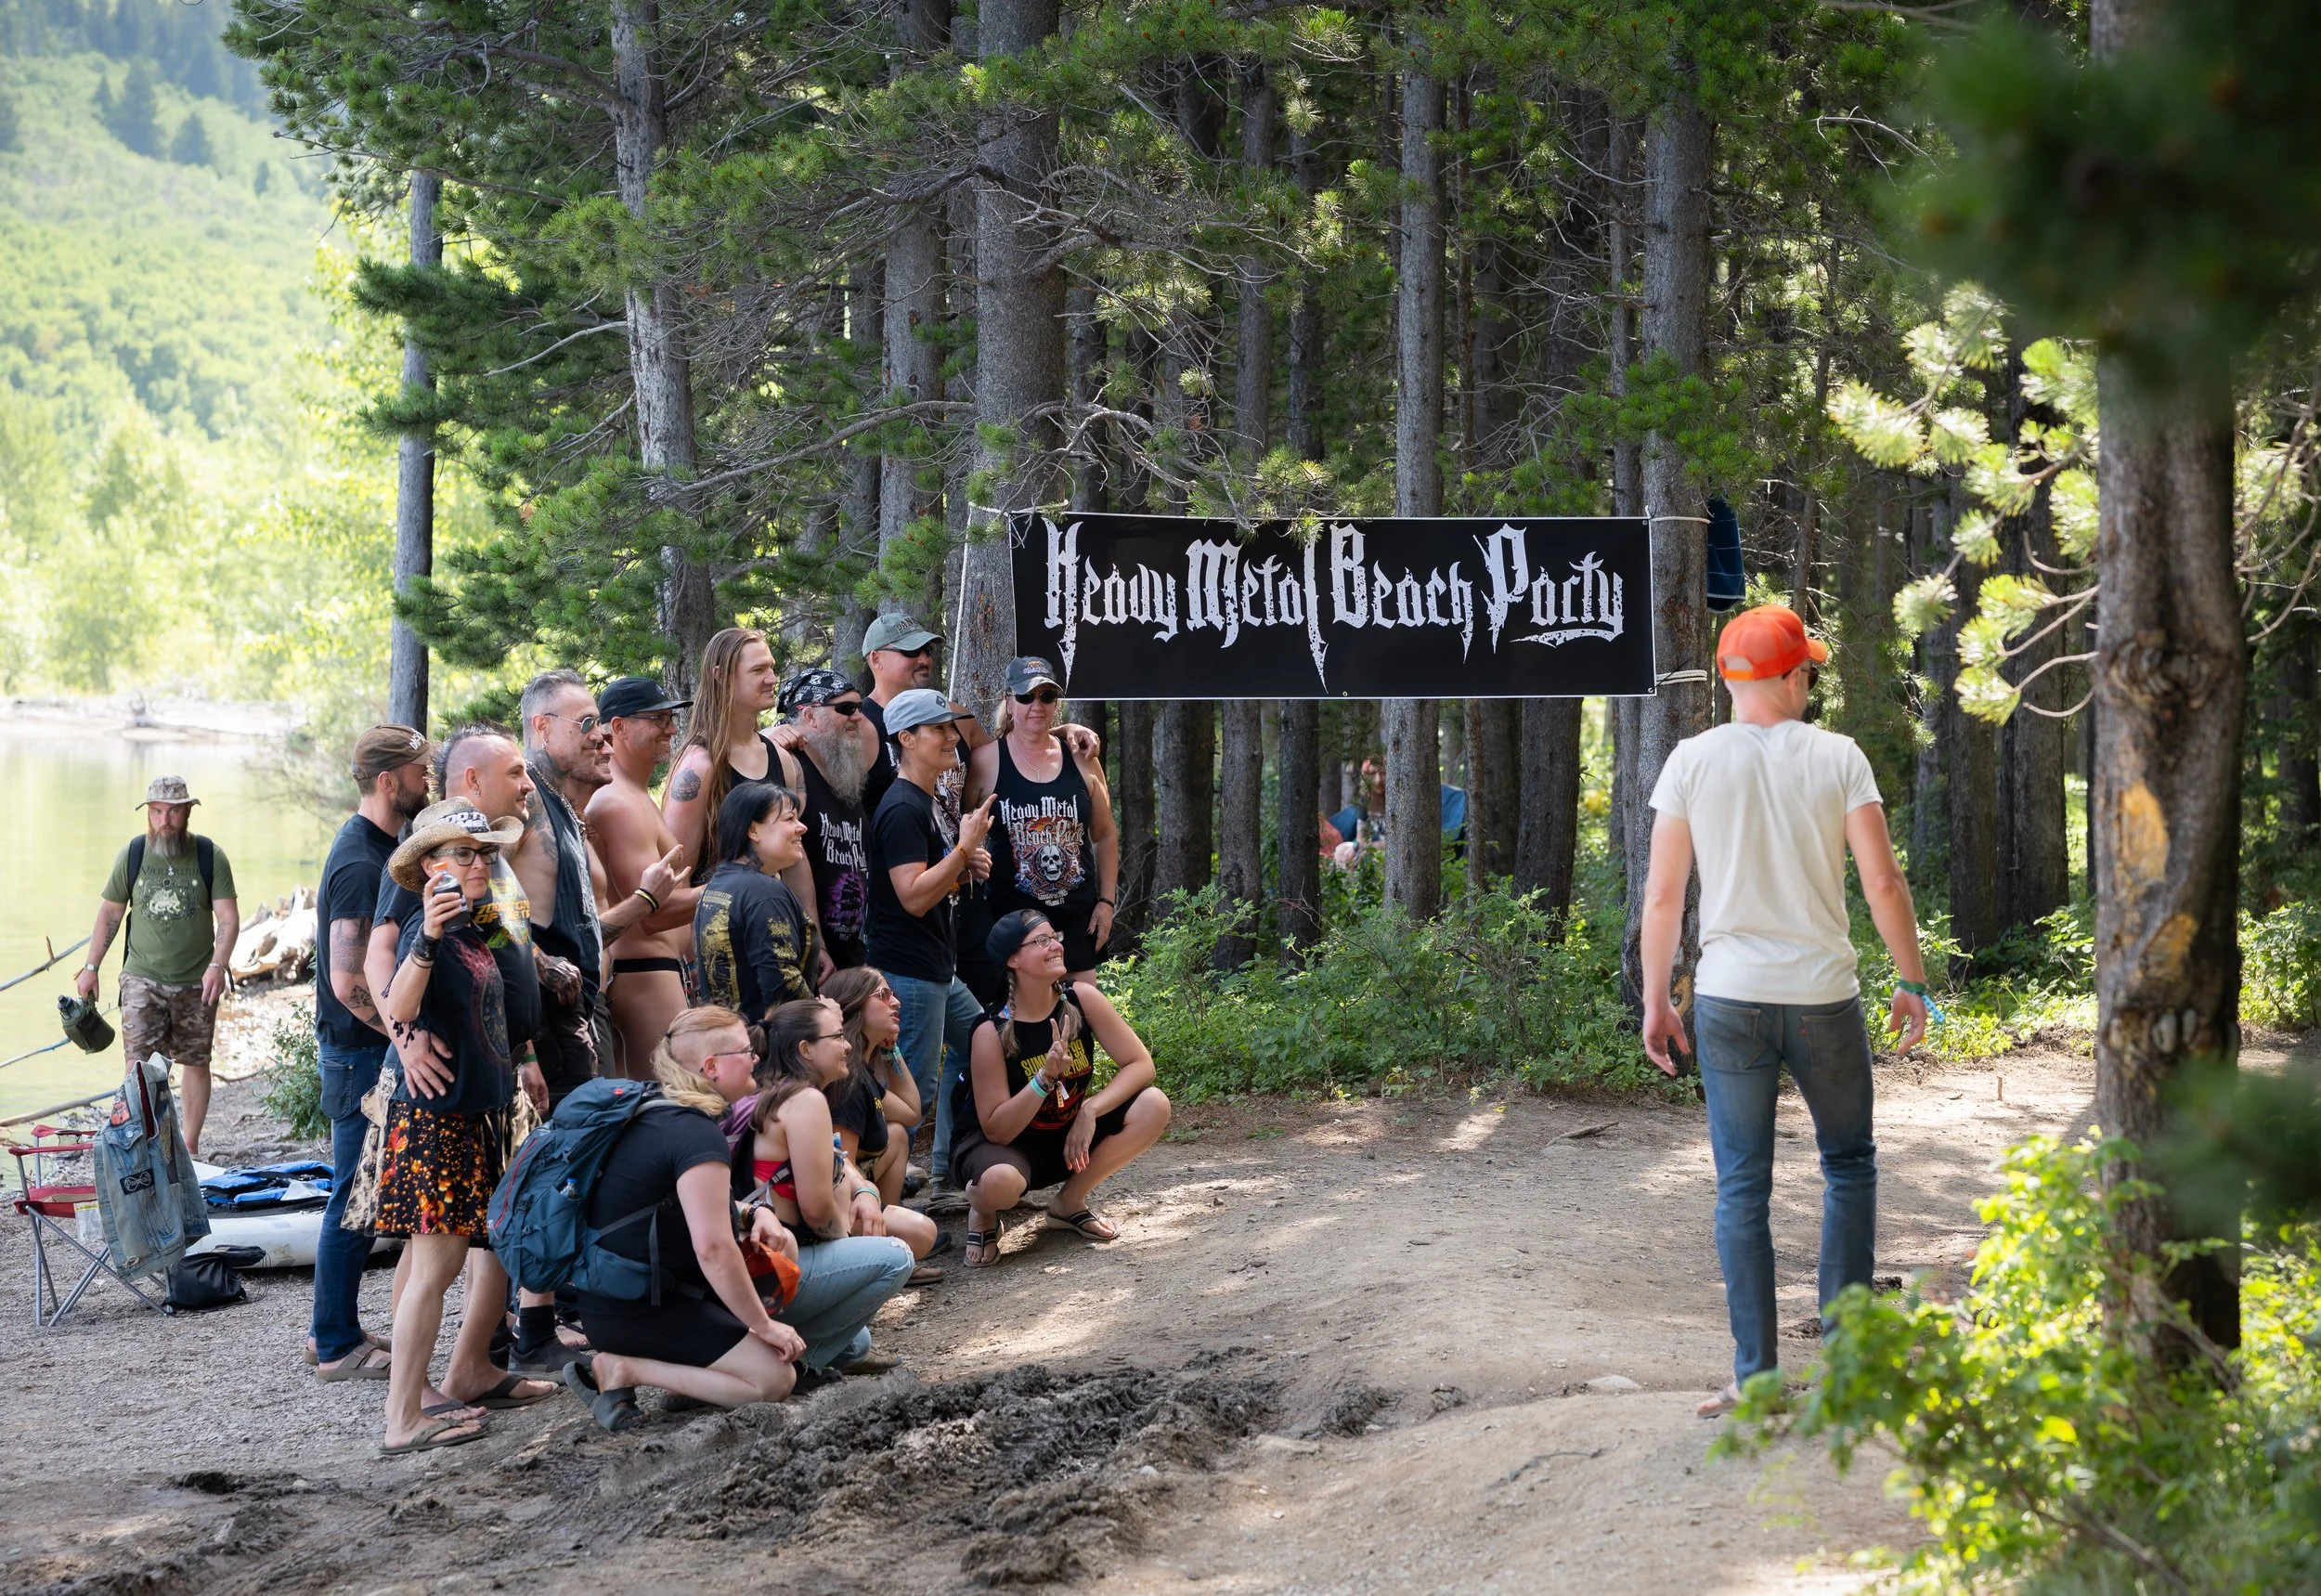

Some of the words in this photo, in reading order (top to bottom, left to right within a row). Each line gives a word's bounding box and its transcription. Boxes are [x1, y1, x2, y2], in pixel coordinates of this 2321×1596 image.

[1042, 516, 1177, 694] Heavy
[1185, 523, 1329, 694] Metal
[1330, 523, 1473, 664] Beach
[1472, 522, 1624, 655] Party
[999, 798, 1040, 832] Heavy
[1040, 795, 1079, 826] Metal
[1012, 821, 1053, 850] Beach
[474, 912, 499, 924] OF
